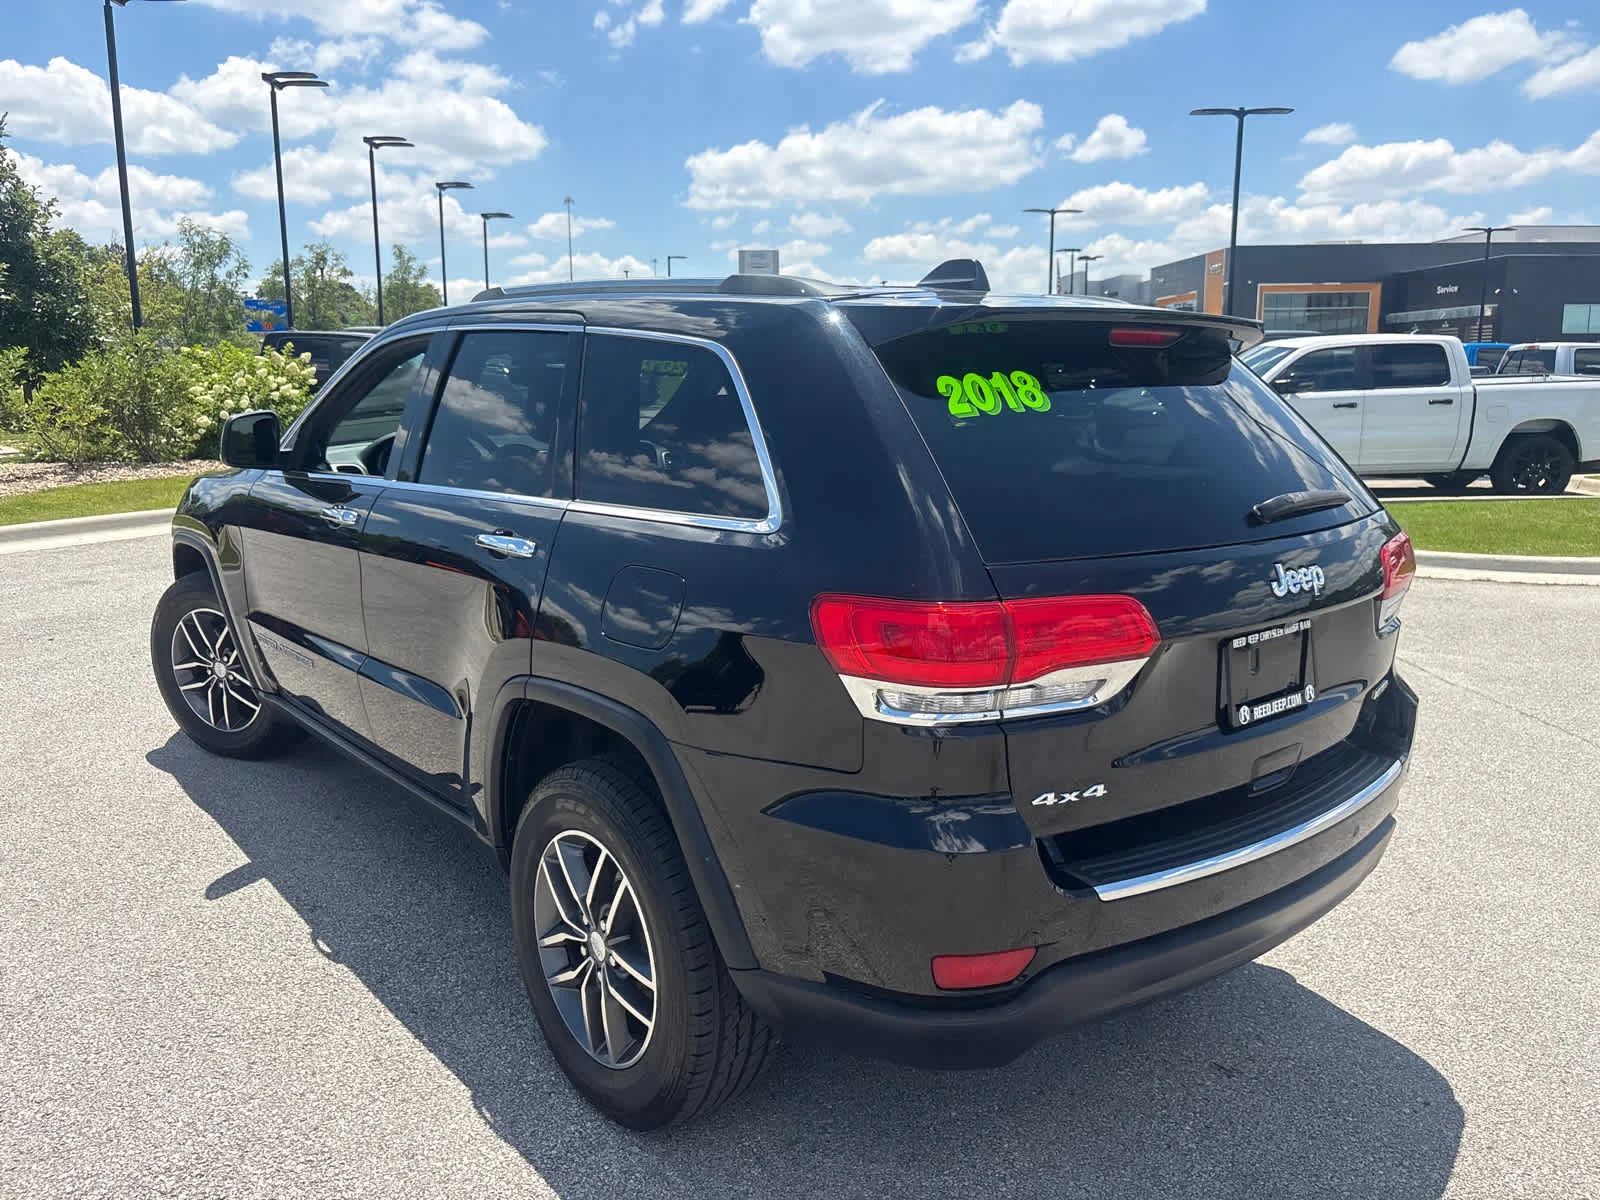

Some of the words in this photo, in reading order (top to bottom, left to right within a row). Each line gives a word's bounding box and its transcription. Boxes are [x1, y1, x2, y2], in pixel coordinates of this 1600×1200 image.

[1436, 284, 1459, 295] Service
[936, 370, 1051, 418] 2018
[1271, 563, 1325, 597] Jeep
[1232, 636, 1247, 649] REED
[1253, 693, 1302, 720] REEDJEEP.COM
[1031, 783, 1108, 806] 4x4
